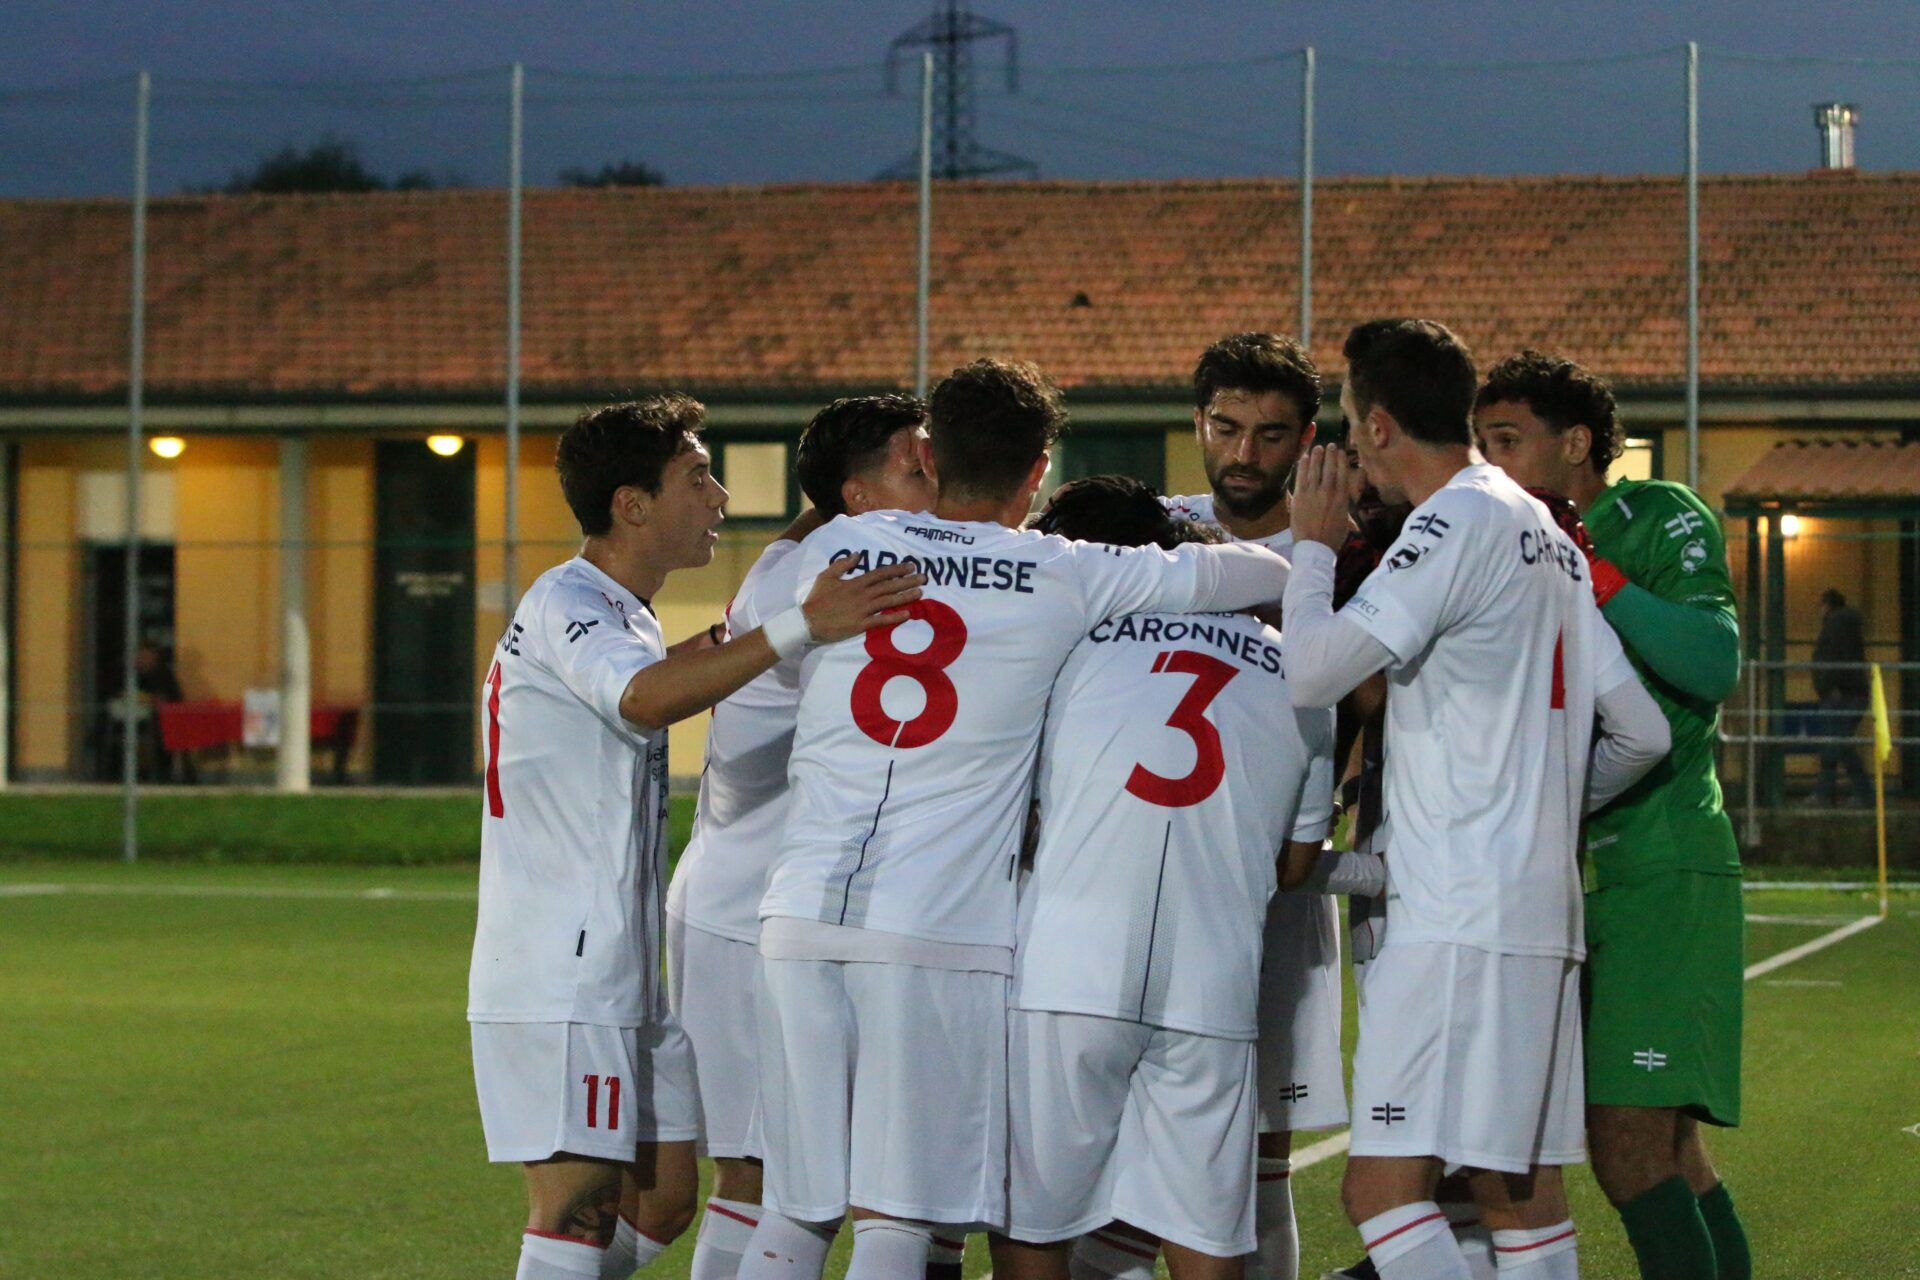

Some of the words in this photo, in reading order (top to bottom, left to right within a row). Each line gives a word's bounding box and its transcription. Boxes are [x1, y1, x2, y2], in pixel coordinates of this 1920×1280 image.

[850, 598, 967, 749] 8
[1089, 617, 1286, 680] CARONNES
[1124, 650, 1241, 808] 3
[582, 1074, 620, 1130] 11
